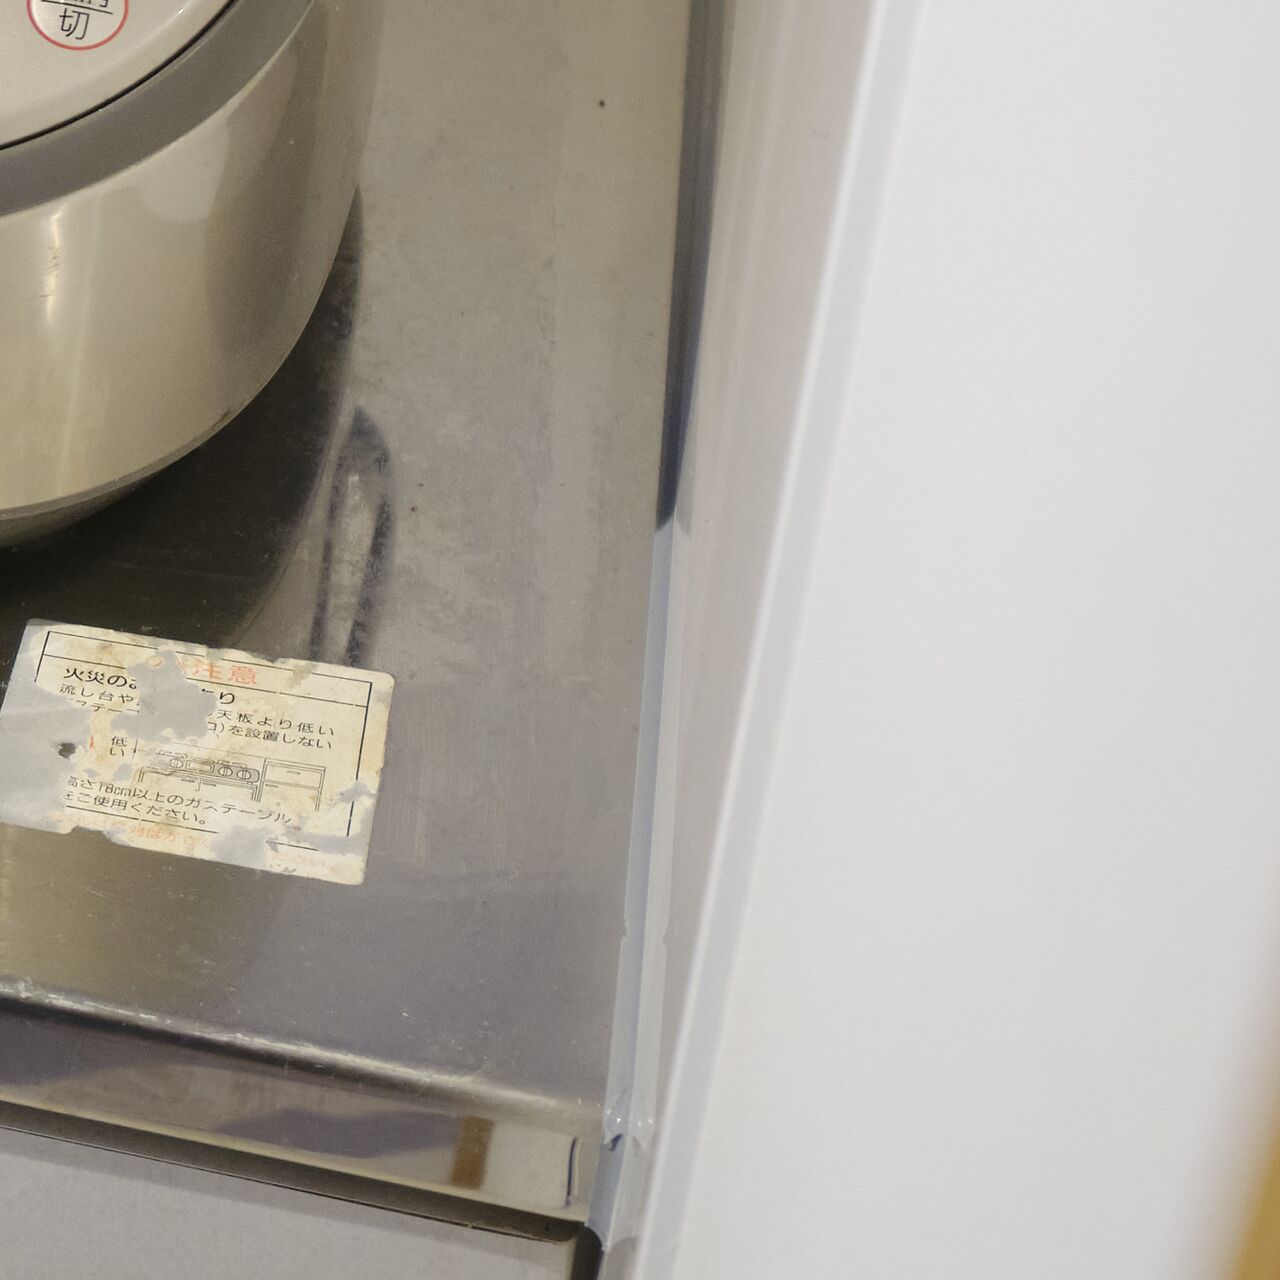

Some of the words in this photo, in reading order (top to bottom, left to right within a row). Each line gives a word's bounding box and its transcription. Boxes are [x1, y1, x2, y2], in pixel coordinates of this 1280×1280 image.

[58, 8, 91, 41] 切
[60, 683, 140, 707] 流し台や
[208, 709, 336, 736] 天板より低い
